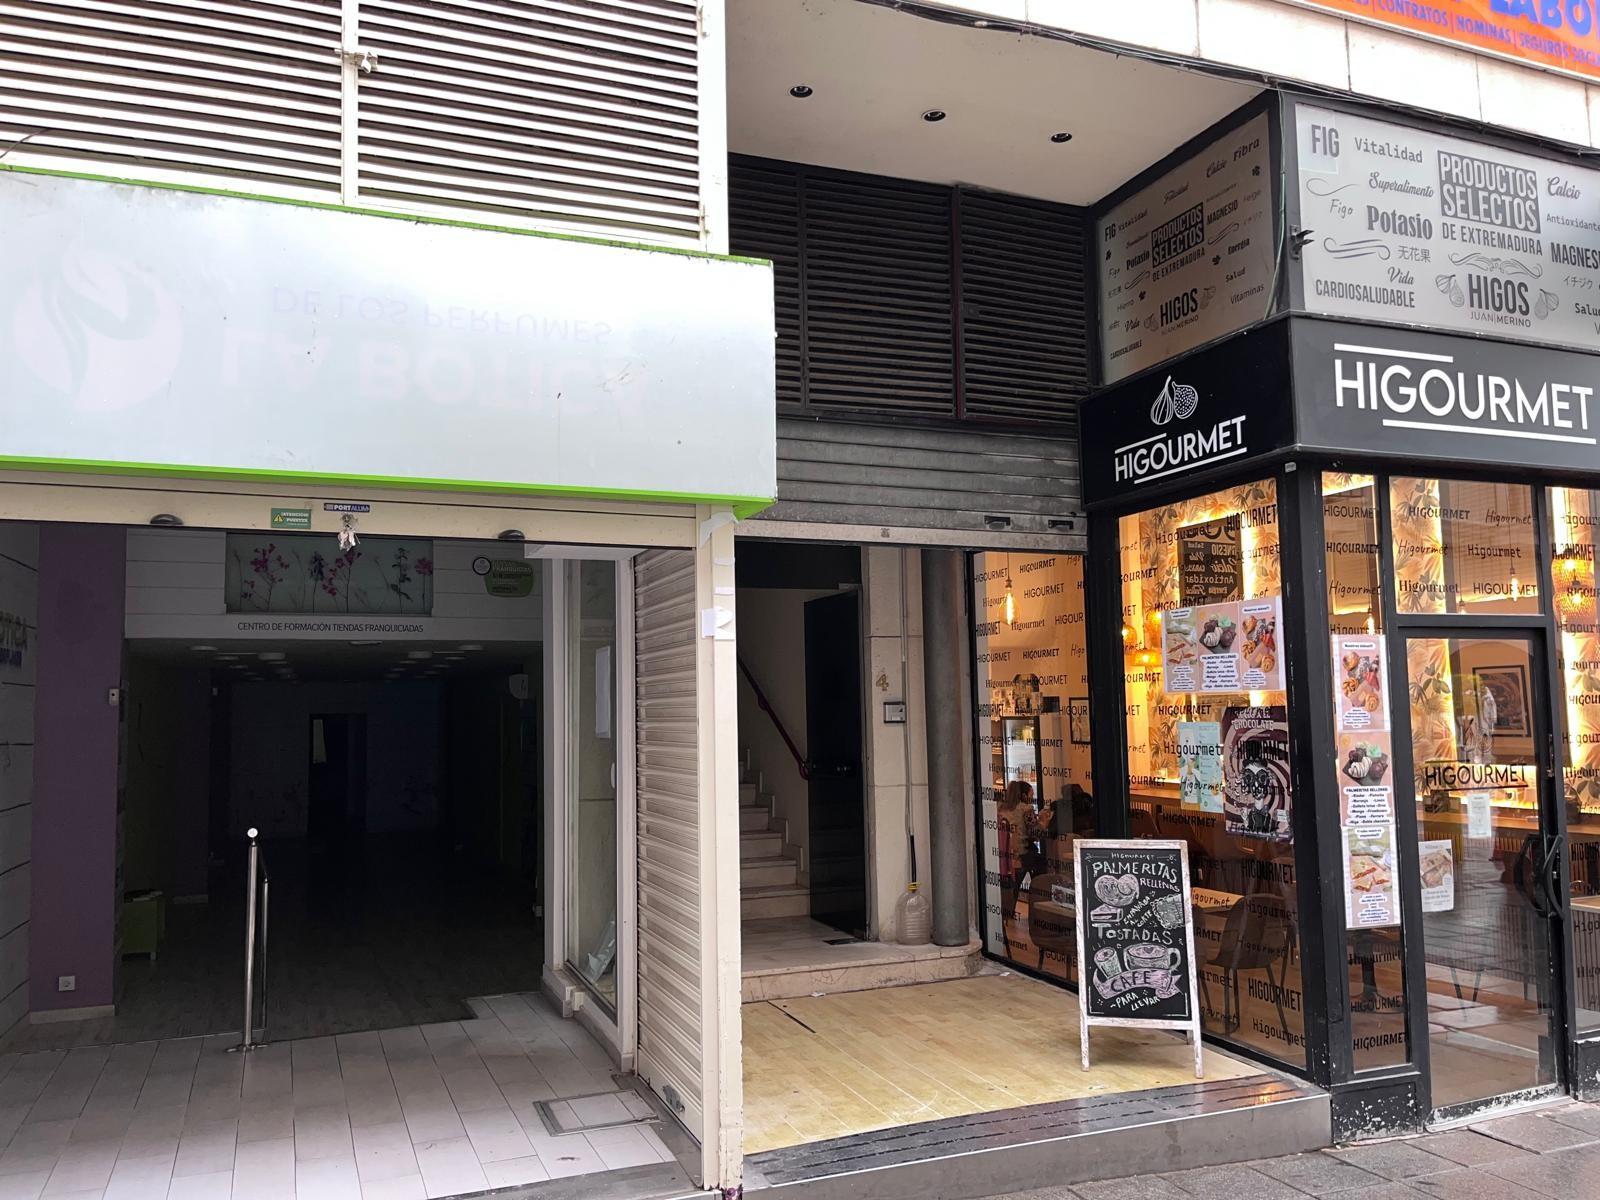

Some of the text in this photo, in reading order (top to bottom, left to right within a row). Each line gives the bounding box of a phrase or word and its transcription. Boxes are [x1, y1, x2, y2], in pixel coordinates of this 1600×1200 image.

[1456, 14, 1512, 45] NOMINAS
[1311, 124, 1340, 158] FIG
[1354, 137, 1423, 164] Vitalidad
[1368, 171, 1434, 198] Superalimento
[1440, 152, 1537, 200] PRODUCTOS
[1547, 176, 1581, 200] Calcio
[1206, 199, 1240, 225] MAGNESIO
[1330, 199, 1354, 220] Figo
[1442, 184, 1538, 232] SELECTOS
[1105, 223, 1117, 242] FIG
[1152, 203, 1203, 248] PRODUCTOS
[1367, 205, 1432, 240] Potasio
[1152, 224, 1204, 268] SELECTOS
[1442, 222, 1543, 256] DE EXTREMADURA
[1161, 247, 1206, 279] EXTREMADURA
[1388, 267, 1415, 285] Vida
[1316, 279, 1416, 309] CARDIOSALUDABLE
[1468, 274, 1530, 316] HIGOS
[1160, 288, 1198, 327] HIGOS
[1334, 359, 1594, 430] HIGOURMET
[1114, 416, 1247, 483] HIGOURMET
[1408, 506, 1471, 521] HIGOURMET
[1485, 508, 1533, 525] Higourmet
[1467, 544, 1521, 560] Higourmet
[1020, 558, 1056, 574] HIGOURMET
[1024, 583, 1064, 598] HIGOURMET
[1399, 579, 1460, 595] Higourmet
[237, 621, 424, 633] CENTRO DE FORMACIÓN TIENDAS FRANQUICIADAS
[1023, 648, 1059, 660] HIGOURMET
[875, 673, 889, 691] 4
[1158, 704, 1212, 717] HIGOURMET
[1164, 740, 1223, 758] Higourmet
[1425, 763, 1527, 787] HIGOURMET
[1092, 861, 1178, 884] PALMERITAS
[1140, 877, 1180, 893] RELLENAS
[1130, 995, 1161, 1012] LLEVAR
[1248, 978, 1302, 1012] HIGOURMET
[1252, 1017, 1306, 1048] Higourmet
